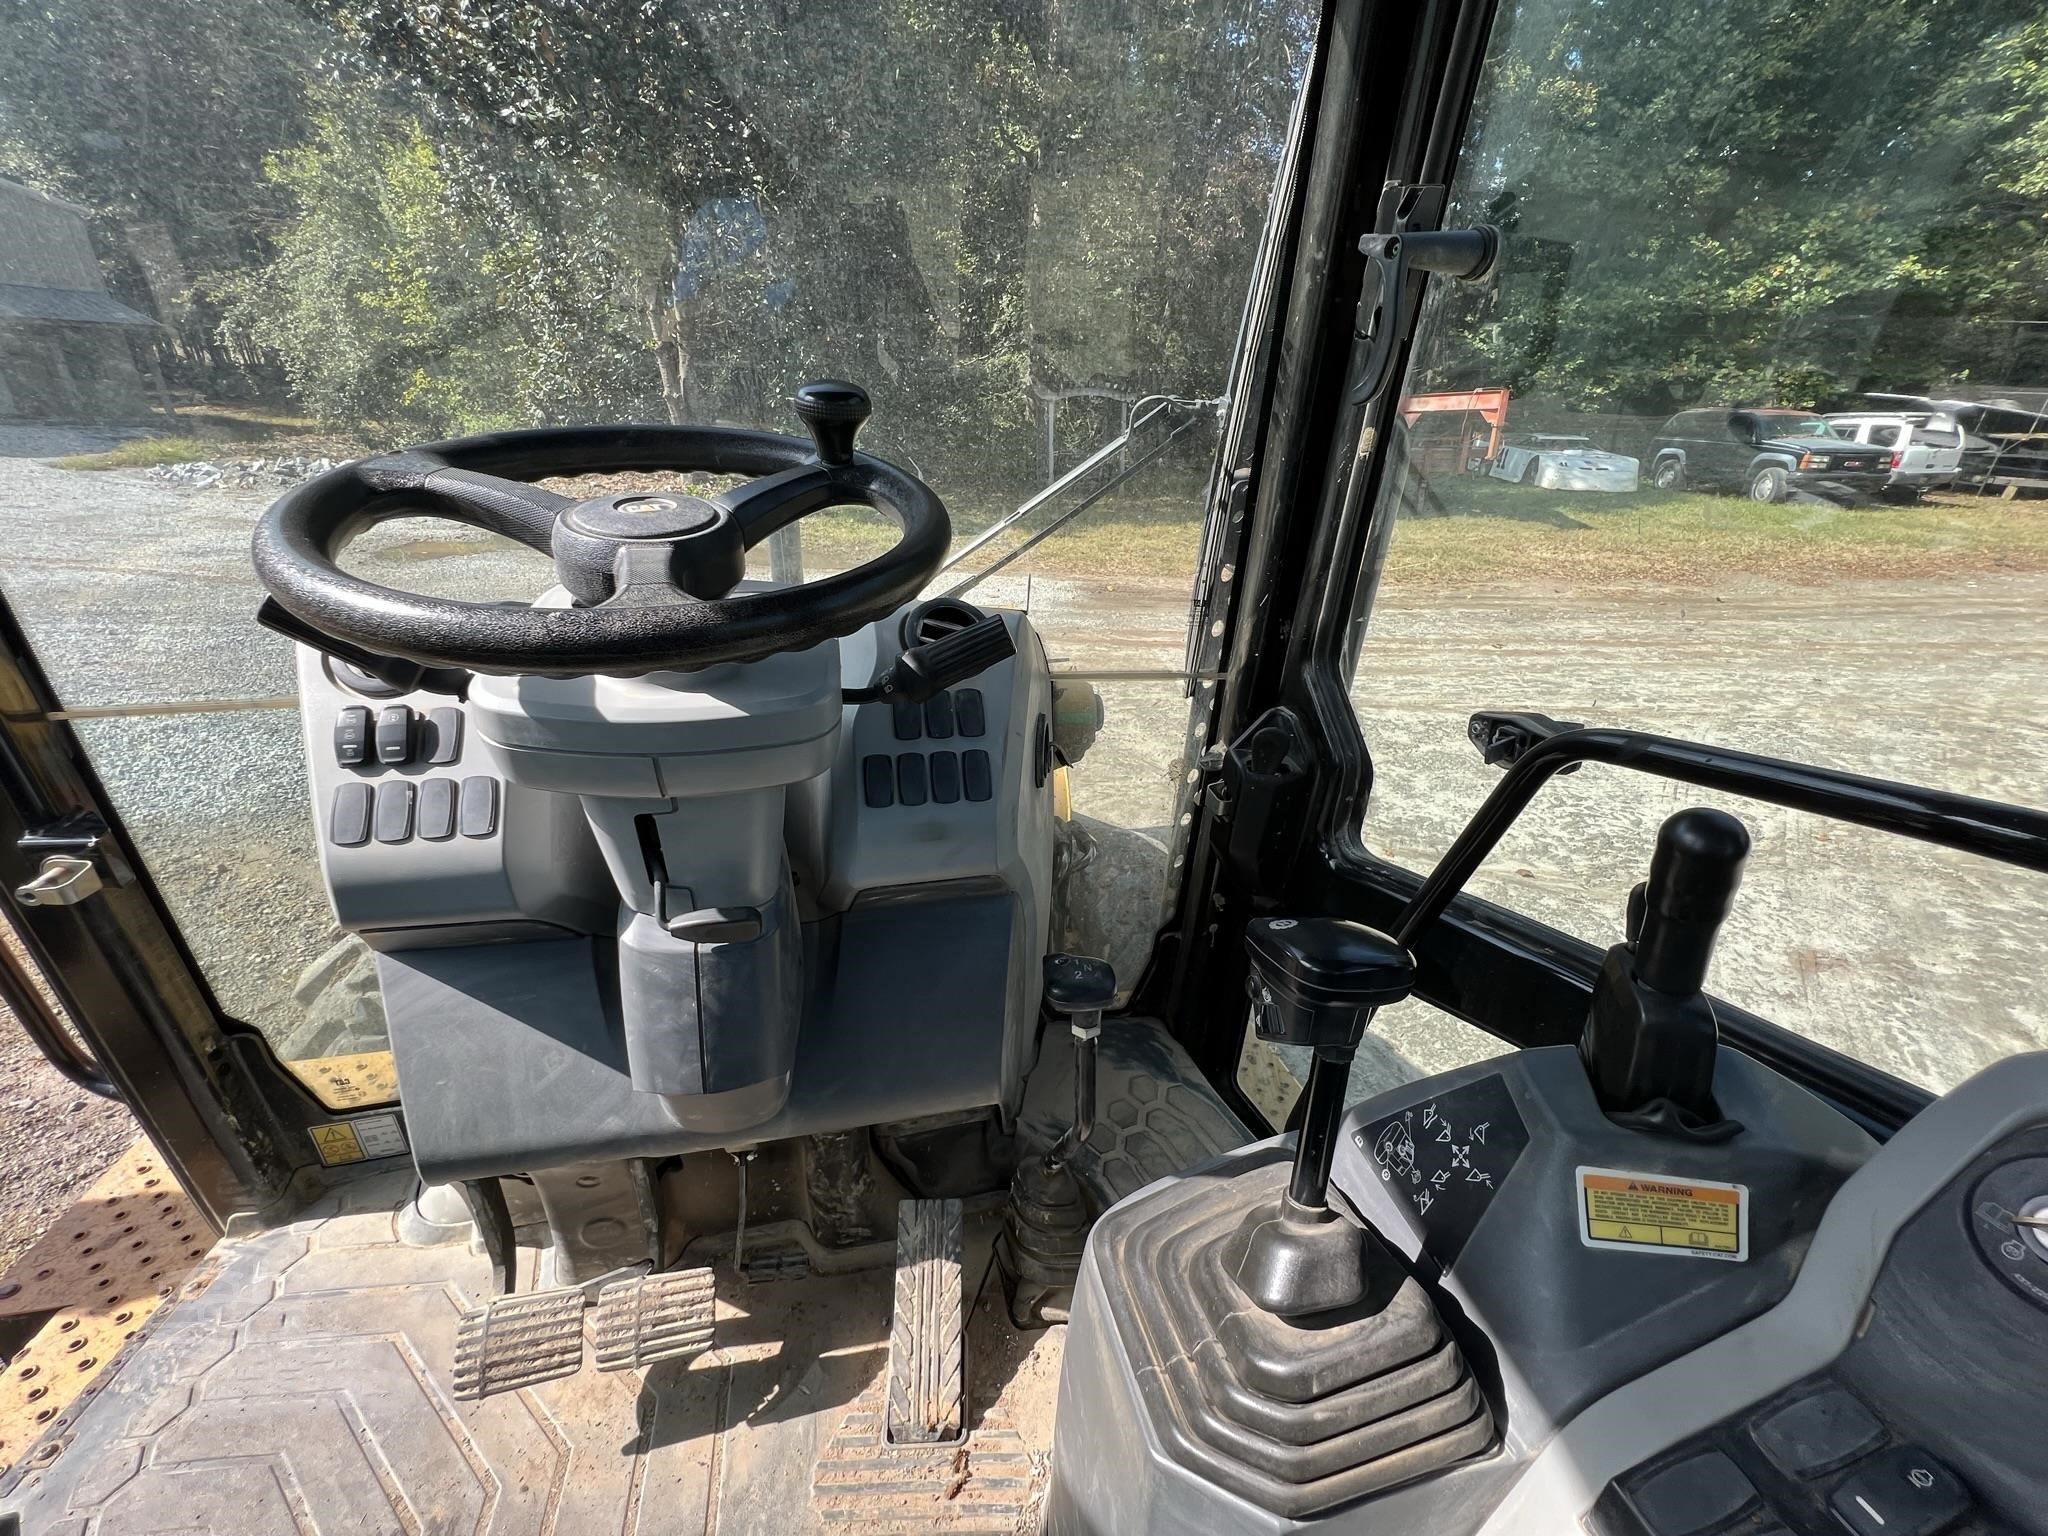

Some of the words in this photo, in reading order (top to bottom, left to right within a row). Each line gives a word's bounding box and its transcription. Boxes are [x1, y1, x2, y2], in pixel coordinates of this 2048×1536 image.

[625, 502, 667, 512] CAT
[1074, 970, 1084, 980] 2
[1640, 1183, 1693, 1197] WARNING
